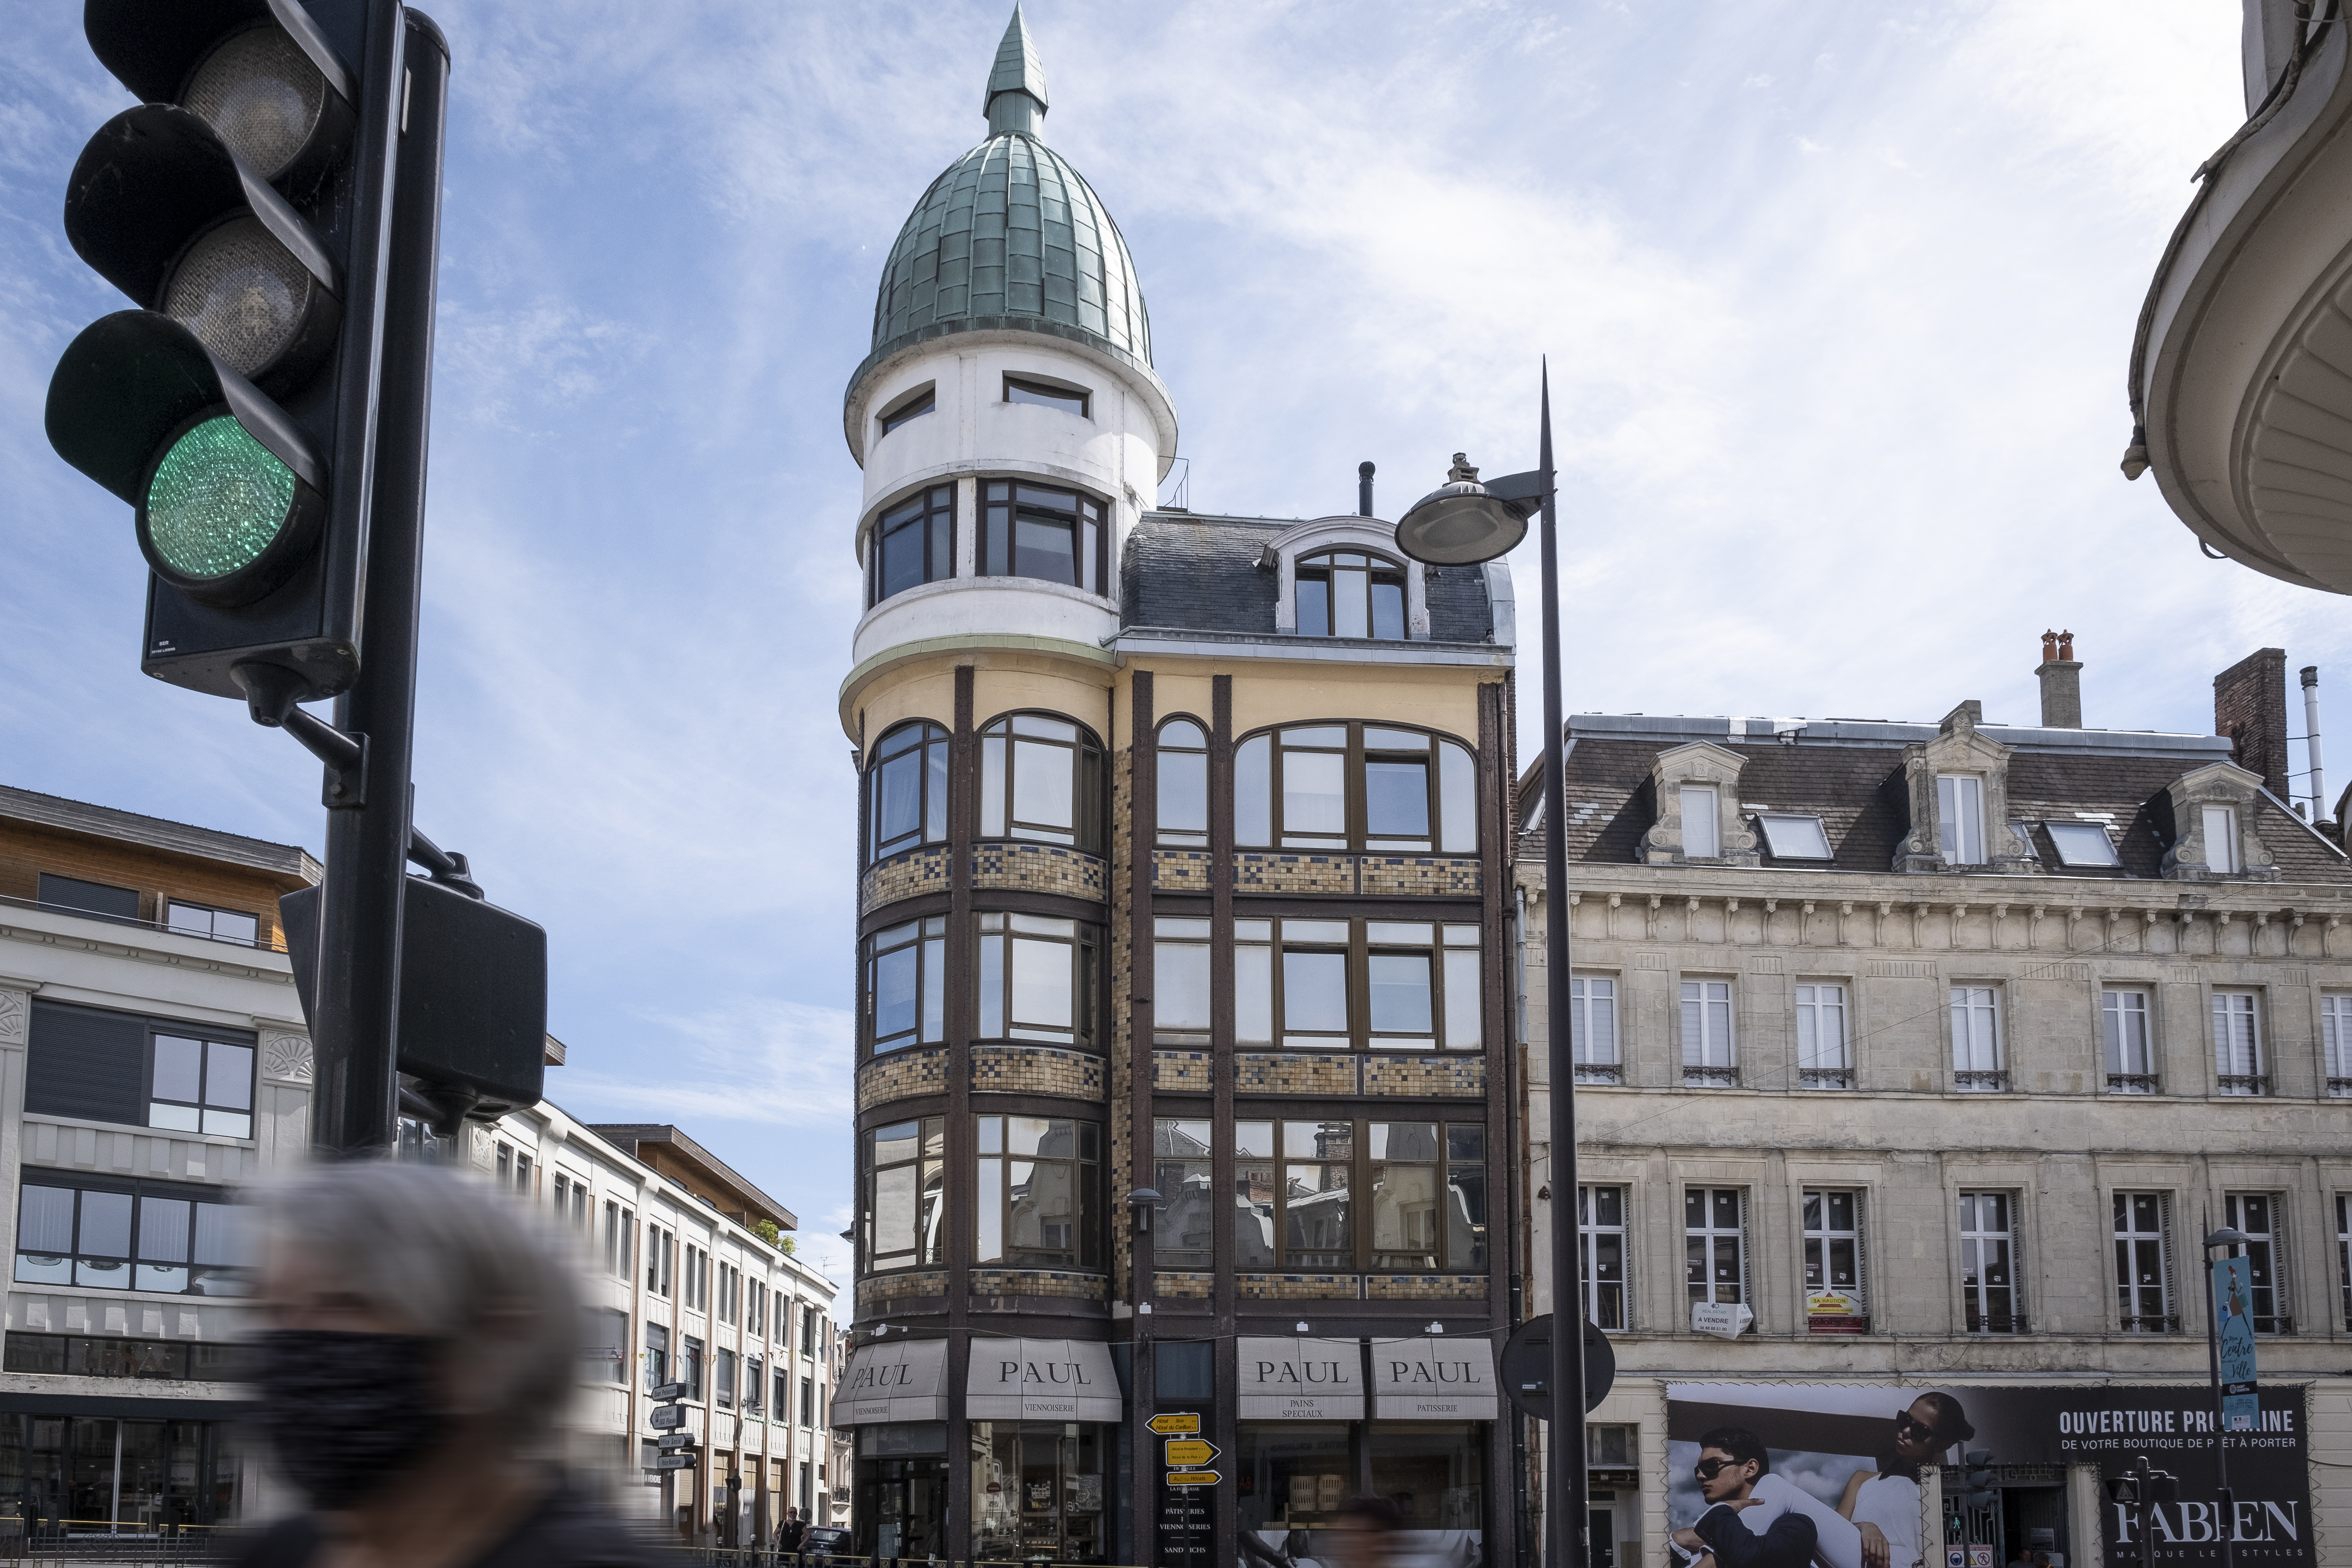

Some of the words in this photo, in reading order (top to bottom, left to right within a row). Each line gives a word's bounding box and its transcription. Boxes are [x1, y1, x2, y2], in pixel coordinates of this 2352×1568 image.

[2220, 1337, 2254, 1359] Centre
[851, 1364, 913, 1389] PAUL
[998, 1361, 1091, 1385] PAUL
[1256, 1361, 1348, 1383] PAUL
[1390, 1361, 1480, 1383] PAUL
[2232, 1360, 2251, 1380] Ville
[855, 1406, 888, 1415] VIENNOISERIE
[1025, 1403, 1075, 1412] VIENNOISERIE
[2060, 1410, 2175, 1434] OUVERTURE
[2183, 1410, 2293, 1432] PRINE
[2062, 1440, 2077, 1449] DE
[2081, 1439, 2119, 1449] VOTRE
[2123, 1439, 2183, 1449] BOUTIQUE
[2188, 1439, 2203, 1448] DE
[2207, 1436, 2235, 1448] PÊT
[2240, 1436, 2247, 1447] À
[2251, 1438, 2296, 1447] PORTER
[644, 1474, 647, 1482] A
[648, 1474, 661, 1484] VENDRE
[2113, 1501, 2298, 1542] FABIEN
